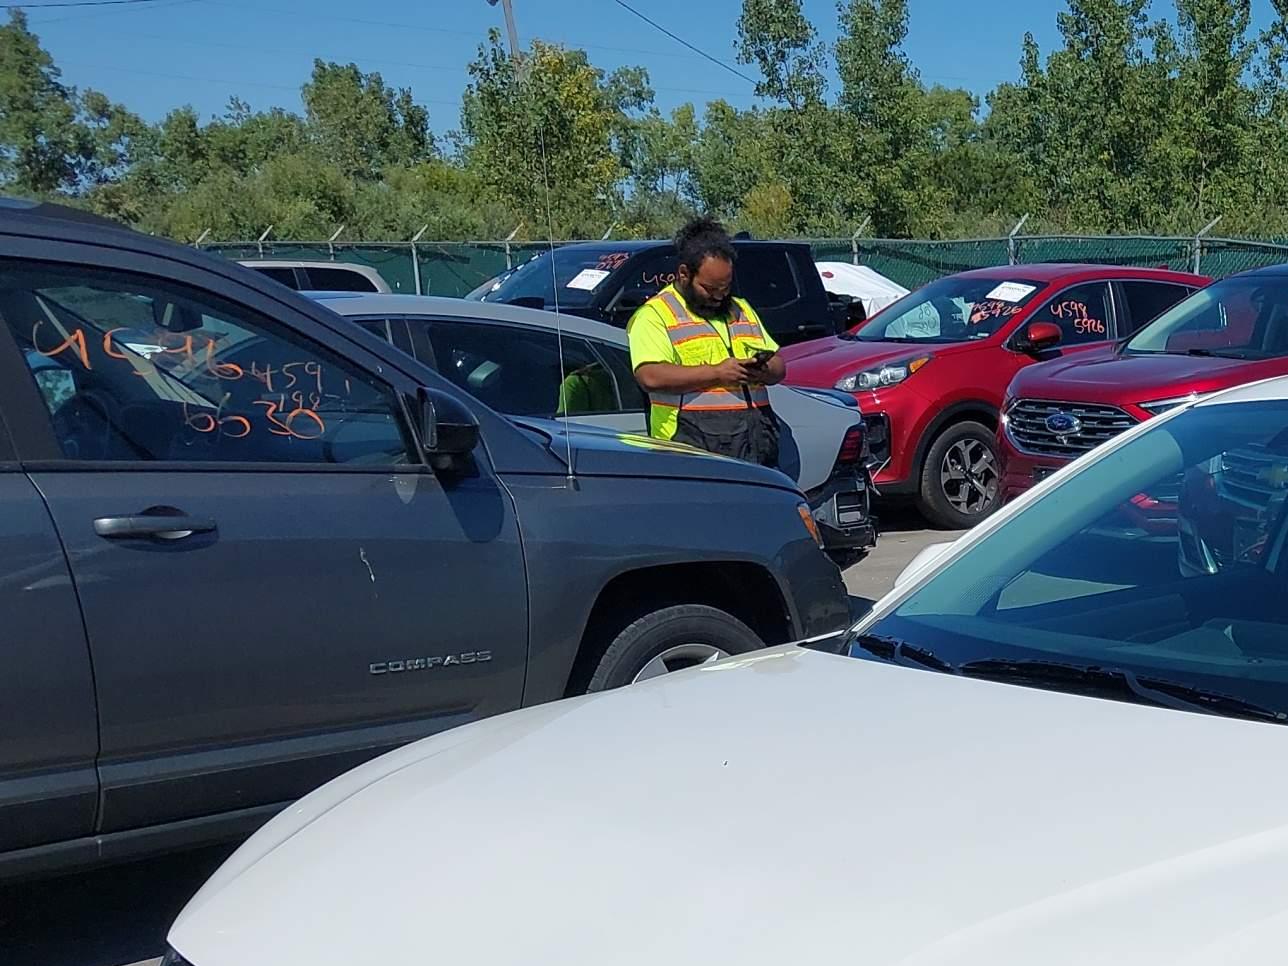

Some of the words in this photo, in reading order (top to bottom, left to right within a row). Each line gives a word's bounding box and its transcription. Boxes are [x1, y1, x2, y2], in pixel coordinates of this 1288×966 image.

[1050, 301, 1088, 319] 4598
[1074, 318, 1105, 334] 5926
[369, 650, 492, 675] COMPASS
